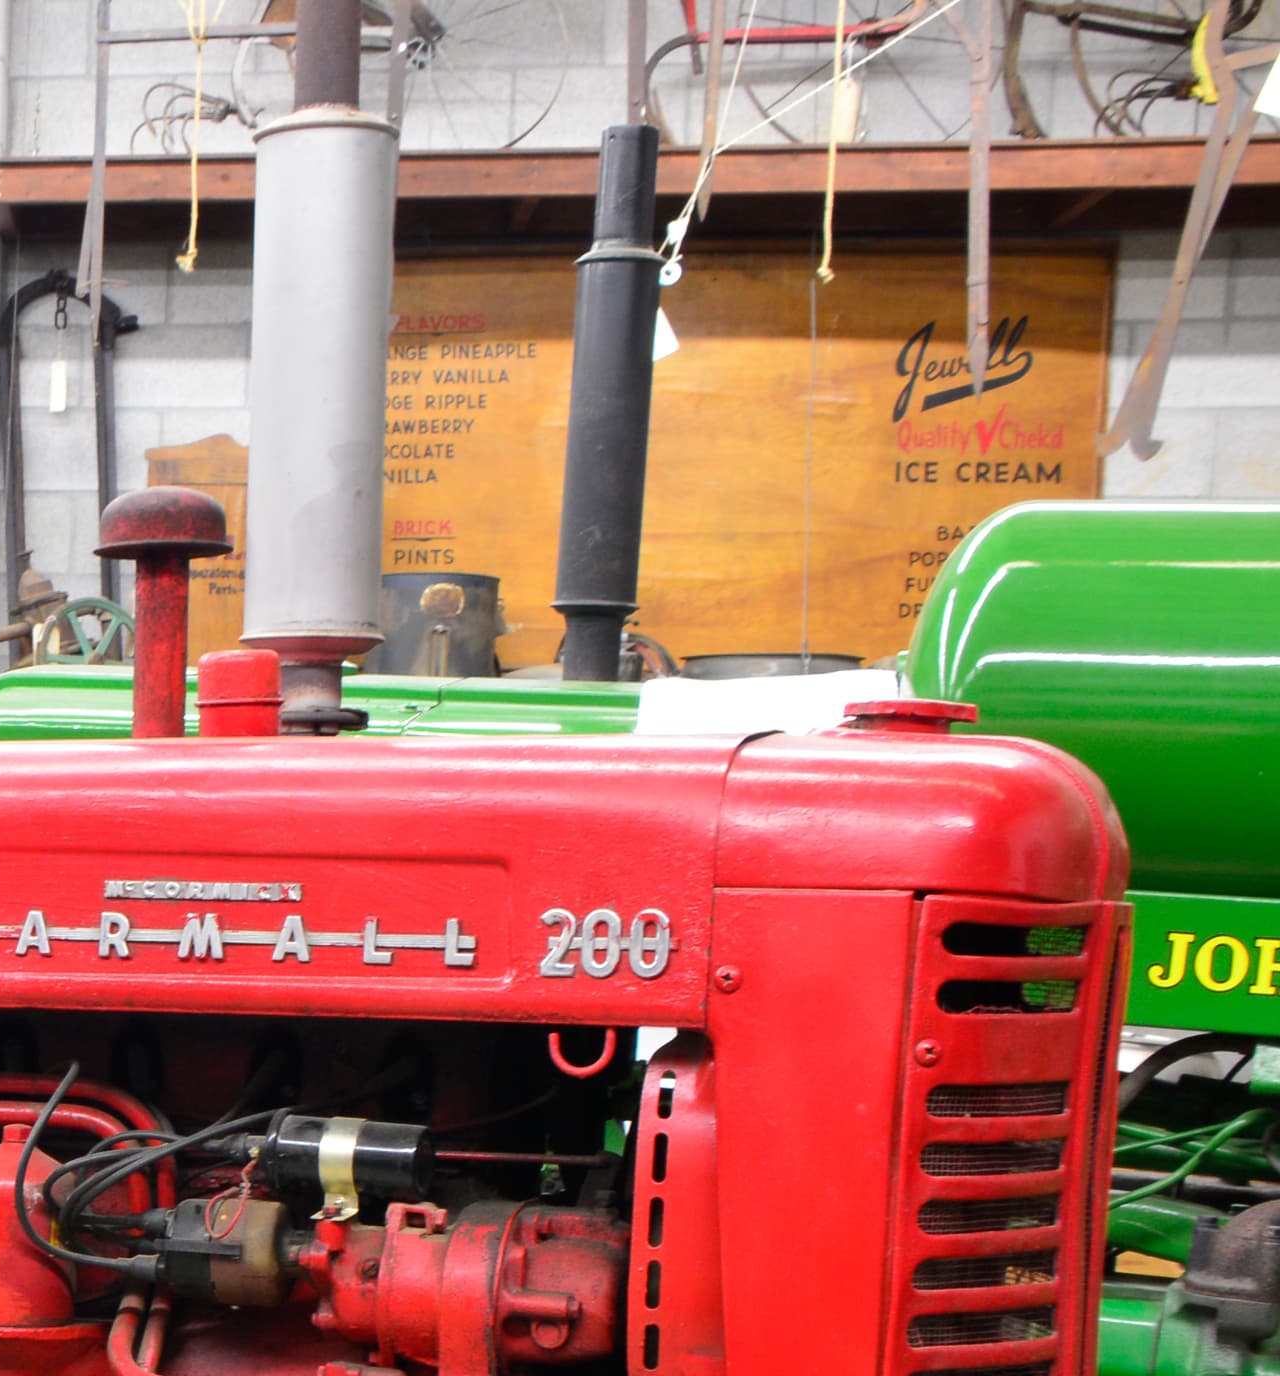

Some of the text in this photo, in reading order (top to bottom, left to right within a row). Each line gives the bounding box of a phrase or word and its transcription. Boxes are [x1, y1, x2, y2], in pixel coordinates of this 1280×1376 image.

[395, 312, 487, 331] FLAVORS
[440, 342, 537, 359] PINEAPPLE
[433, 368, 510, 385] VANILLA
[893, 315, 1033, 423] Jewll
[424, 394, 488, 410] RIPPLE
[897, 419, 972, 456] Quality
[895, 461, 1063, 484] ICE CREAM
[392, 518, 454, 536] BRICK
[394, 548, 456, 566] PINTS
[538, 907, 673, 980] 200
